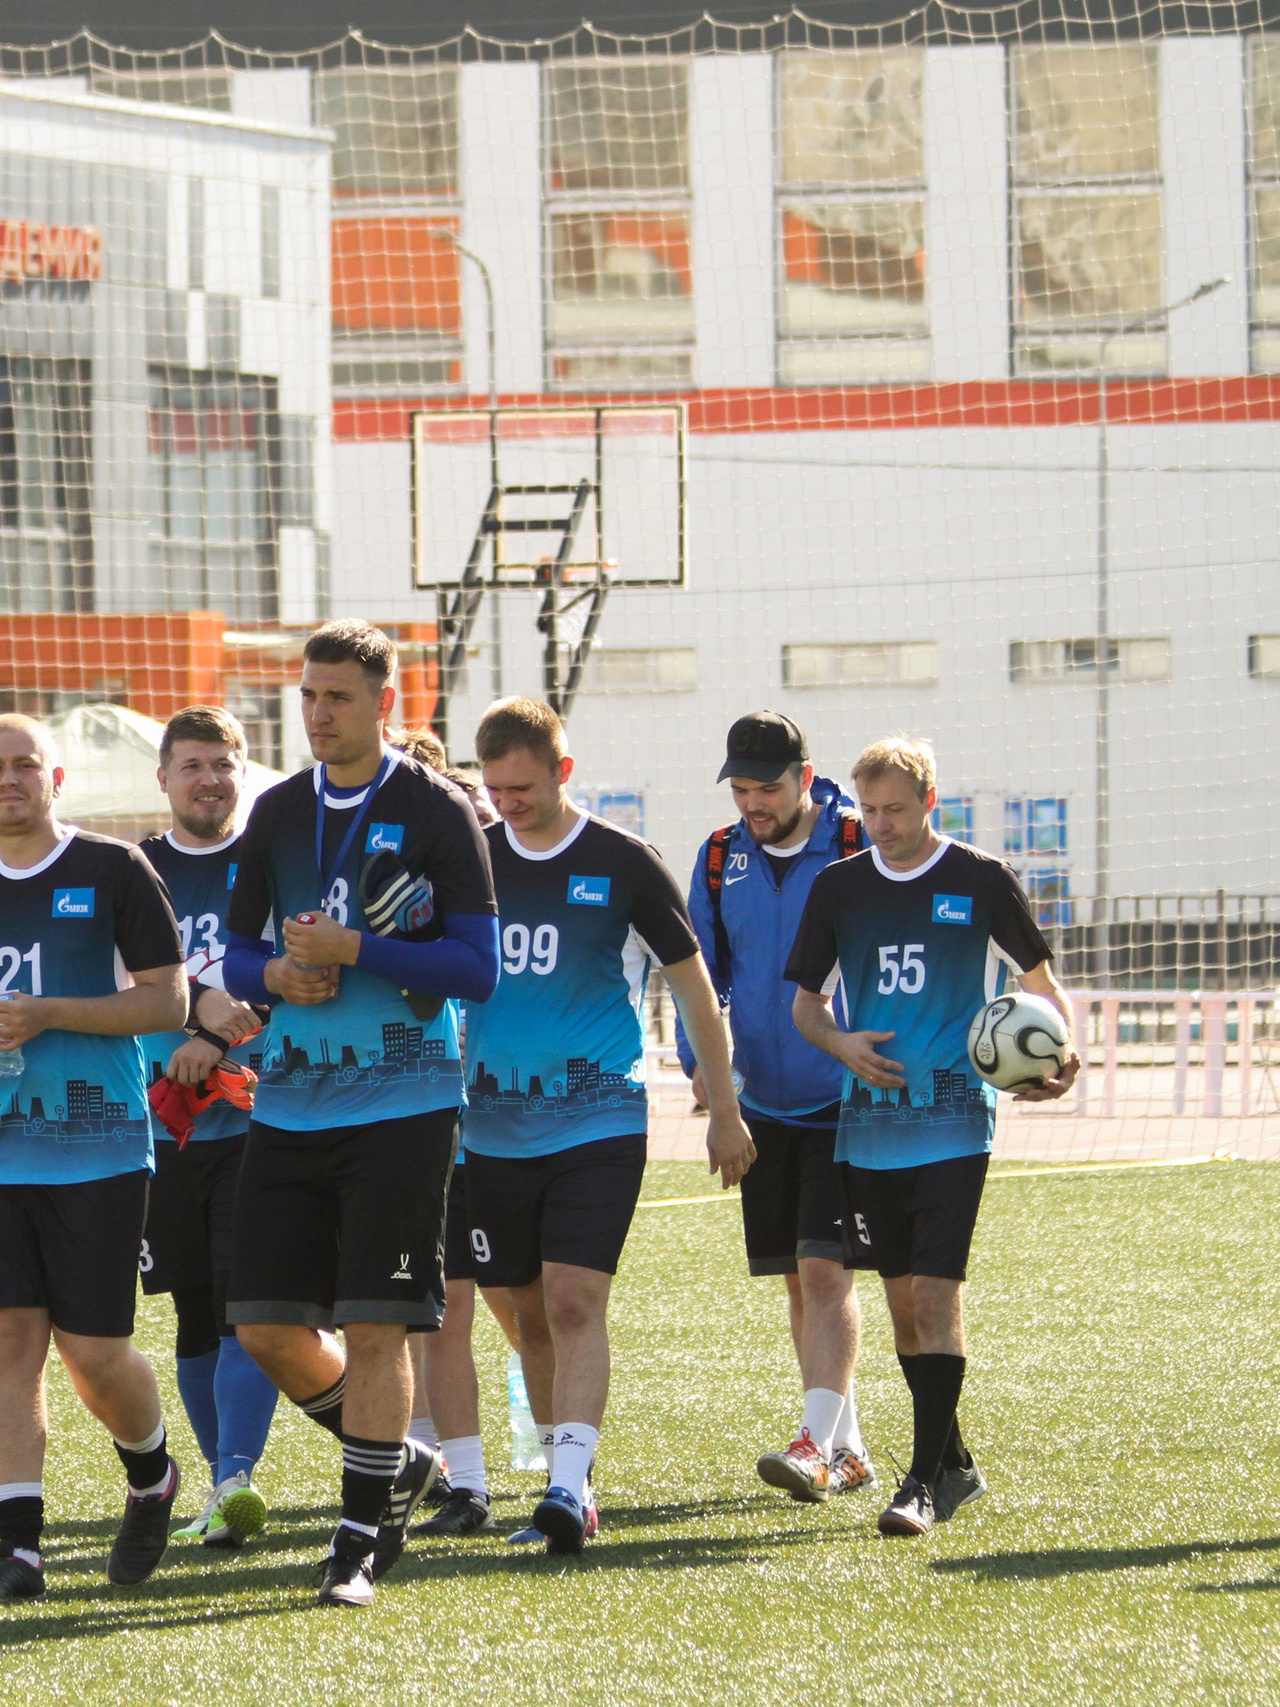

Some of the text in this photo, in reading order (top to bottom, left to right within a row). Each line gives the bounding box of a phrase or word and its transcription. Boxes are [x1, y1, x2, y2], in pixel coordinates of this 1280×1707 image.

[709, 845, 723, 872] NIKE
[728, 853, 748, 871] 70
[178, 913, 220, 959] 13
[503, 923, 559, 975] 99
[877, 944, 925, 995] 55
